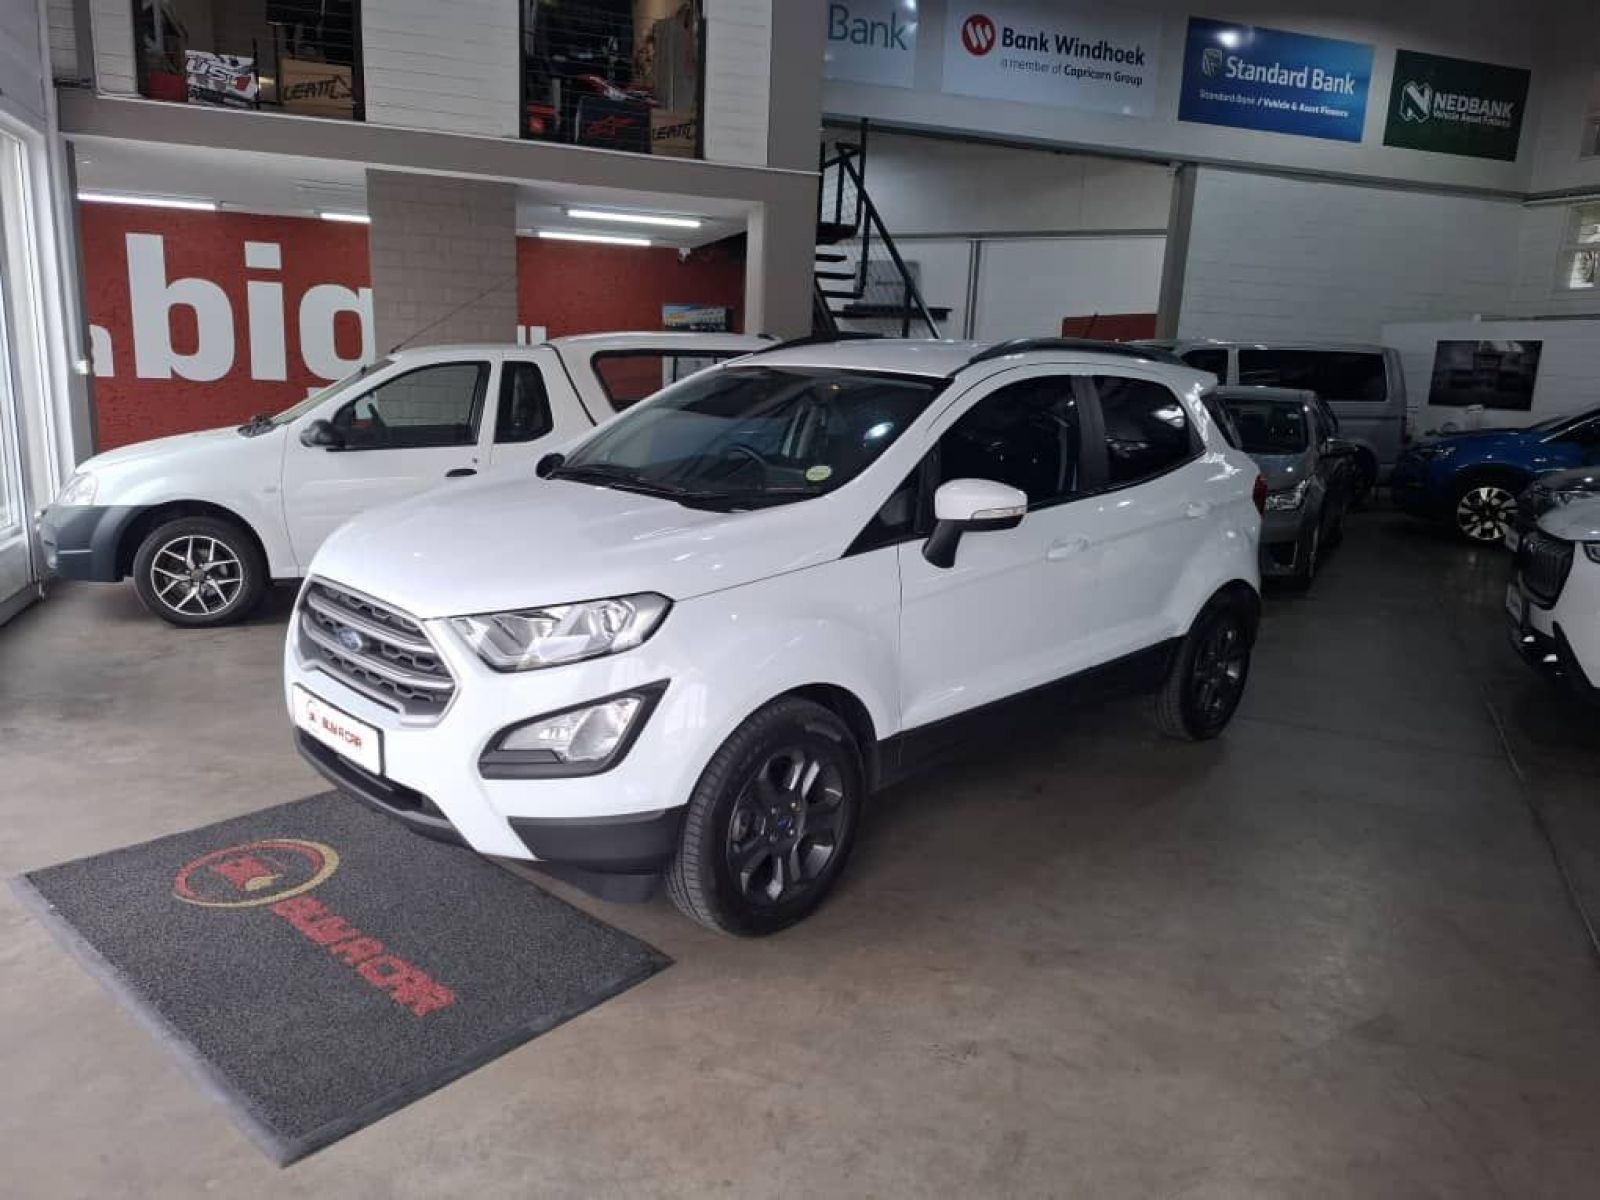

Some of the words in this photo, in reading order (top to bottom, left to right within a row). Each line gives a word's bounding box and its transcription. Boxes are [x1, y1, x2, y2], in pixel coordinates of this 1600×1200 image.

[827, 3, 907, 51] Bank
[1002, 27, 1049, 53] Bank
[1054, 34, 1145, 65] Windhoek
[1009, 59, 1049, 73] member
[1052, 63, 1061, 75] of
[1064, 64, 1111, 80] Capricorn
[1114, 71, 1143, 88] Group
[1225, 56, 1307, 88] Standard
[1311, 68, 1356, 95] Bank
[1433, 92, 1514, 119] NEDBANK
